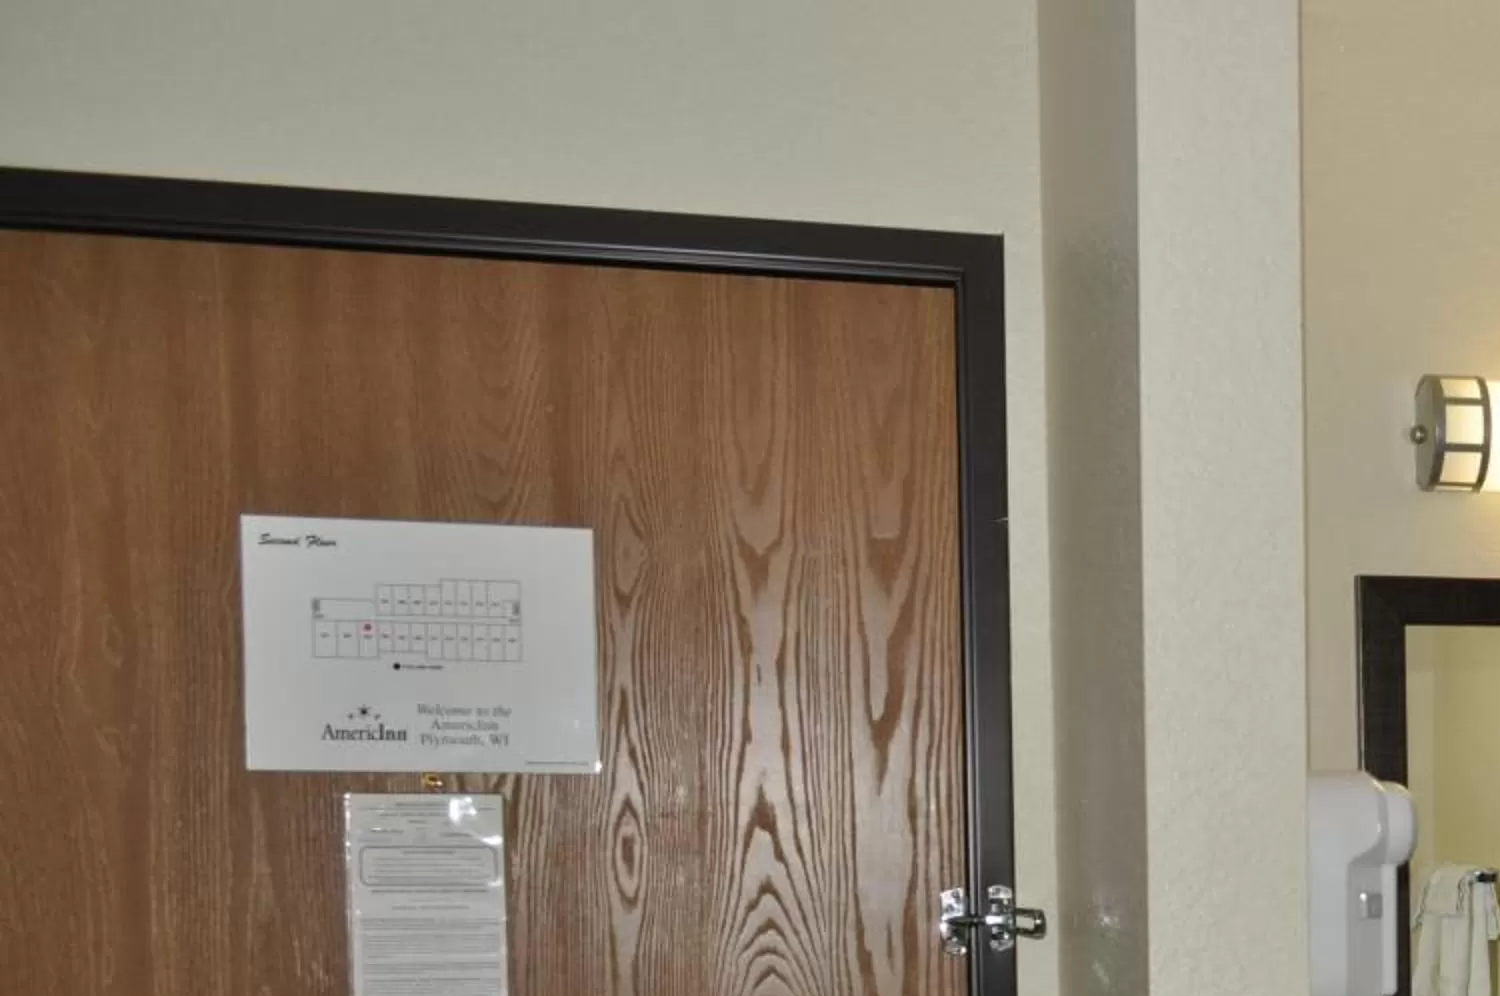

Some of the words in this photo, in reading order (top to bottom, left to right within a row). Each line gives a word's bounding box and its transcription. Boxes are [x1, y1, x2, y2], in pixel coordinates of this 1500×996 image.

[417, 703, 472, 717] Welcome
[492, 704, 512, 718] the
[321, 723, 407, 741] AmericInn
